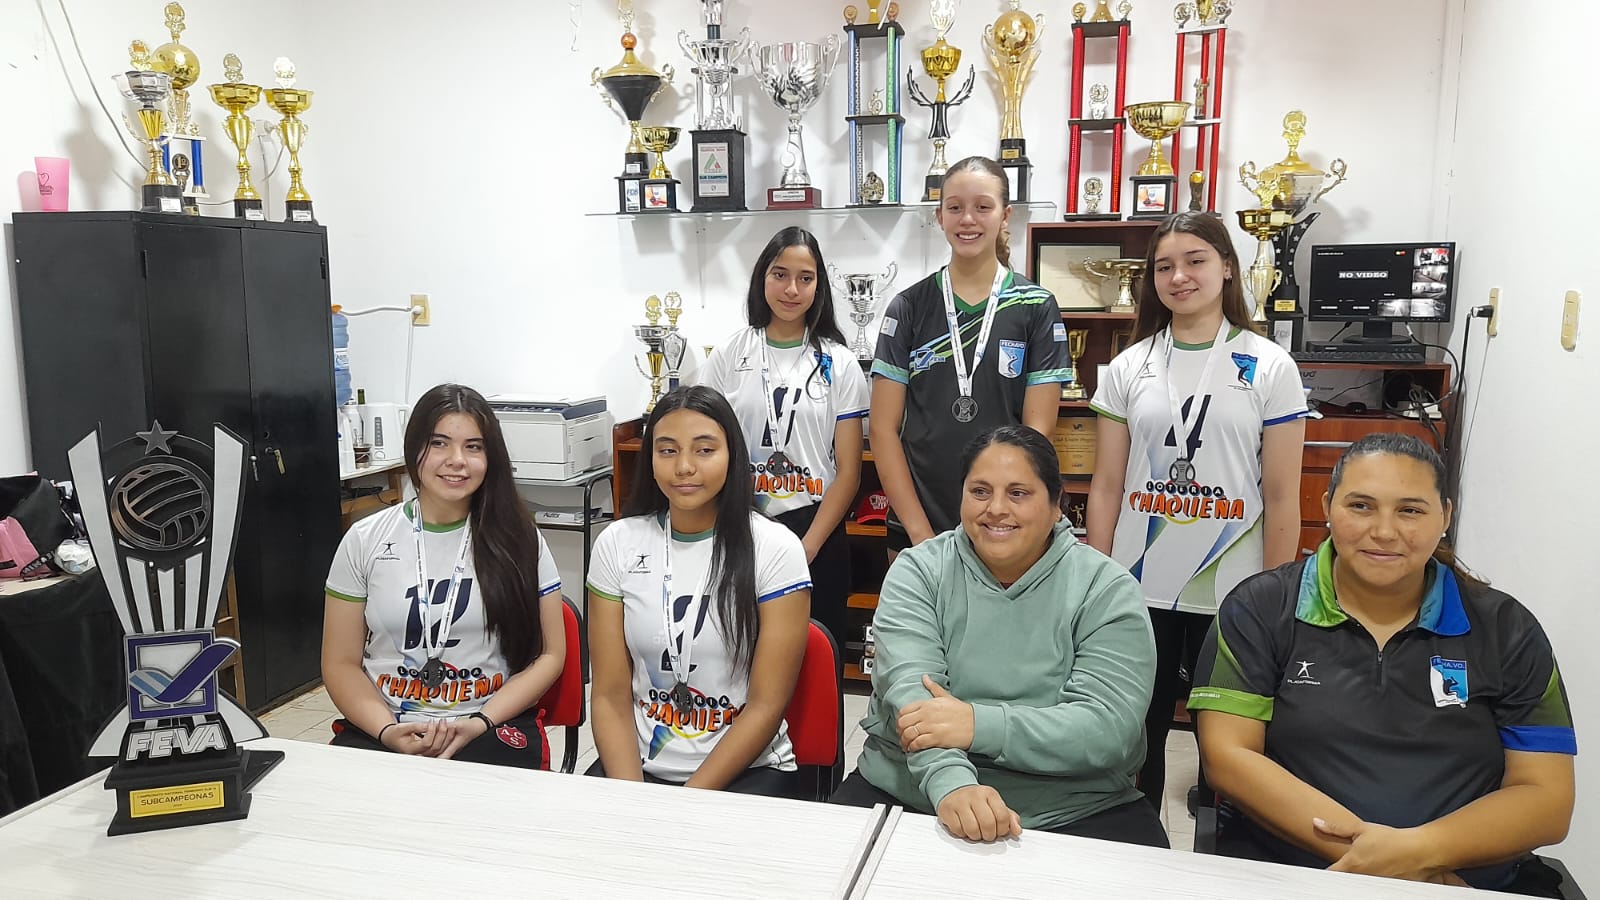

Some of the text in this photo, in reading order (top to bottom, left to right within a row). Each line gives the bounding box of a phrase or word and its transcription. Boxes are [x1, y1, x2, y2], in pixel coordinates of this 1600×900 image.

[1129, 491, 1245, 520] CHAQUEÑA
[404, 578, 473, 651] 12
[126, 723, 227, 760] FEVA
[140, 791, 214, 806] SUBCAMPEONAS
